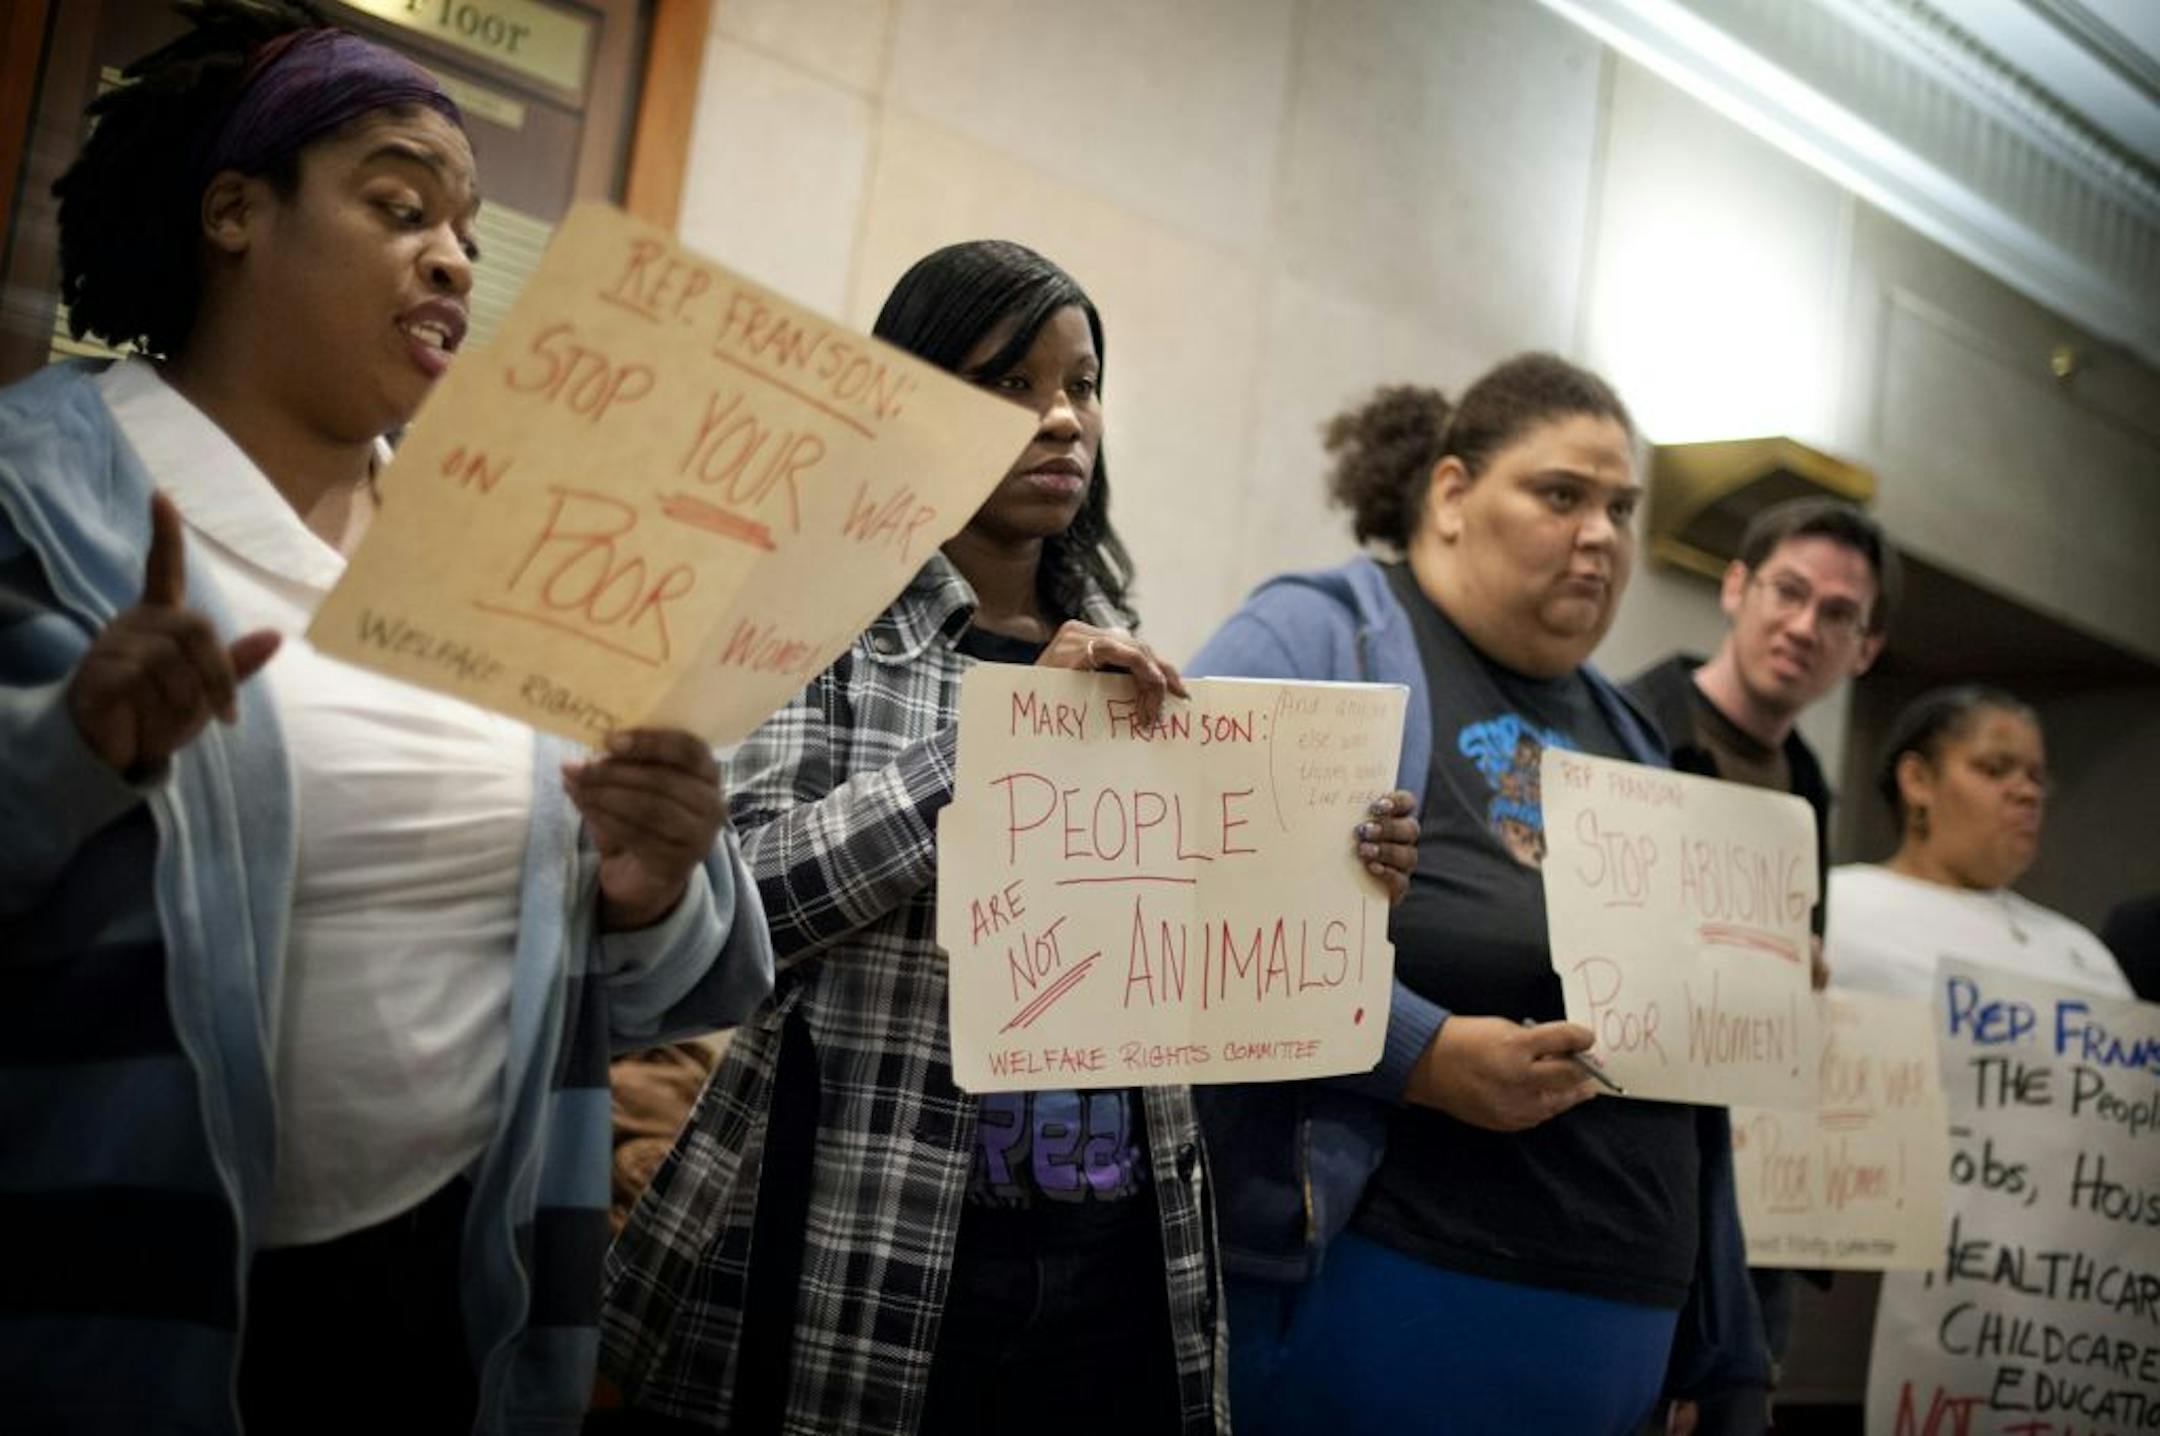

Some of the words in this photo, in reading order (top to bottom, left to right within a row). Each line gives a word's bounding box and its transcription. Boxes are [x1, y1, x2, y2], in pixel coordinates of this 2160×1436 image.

[506, 322, 656, 424] STOP
[677, 390, 828, 534] YOUR
[504, 485, 697, 664] POOR
[1012, 690, 1088, 741] MARY
[990, 773, 1258, 865] PEOPLE
[1574, 808, 1658, 899] STOP
[1679, 838, 1806, 927] ABUSING
[971, 879, 1026, 945] ARE
[1008, 916, 1068, 1001] NOT
[1123, 893, 1369, 1025] ANIMALS!
[988, 1052, 1106, 1078] WELFARE
[1119, 1043, 1211, 1071] RIGHTS
[1572, 957, 1669, 1068] POOR
[1969, 1057, 2054, 1110] THE
